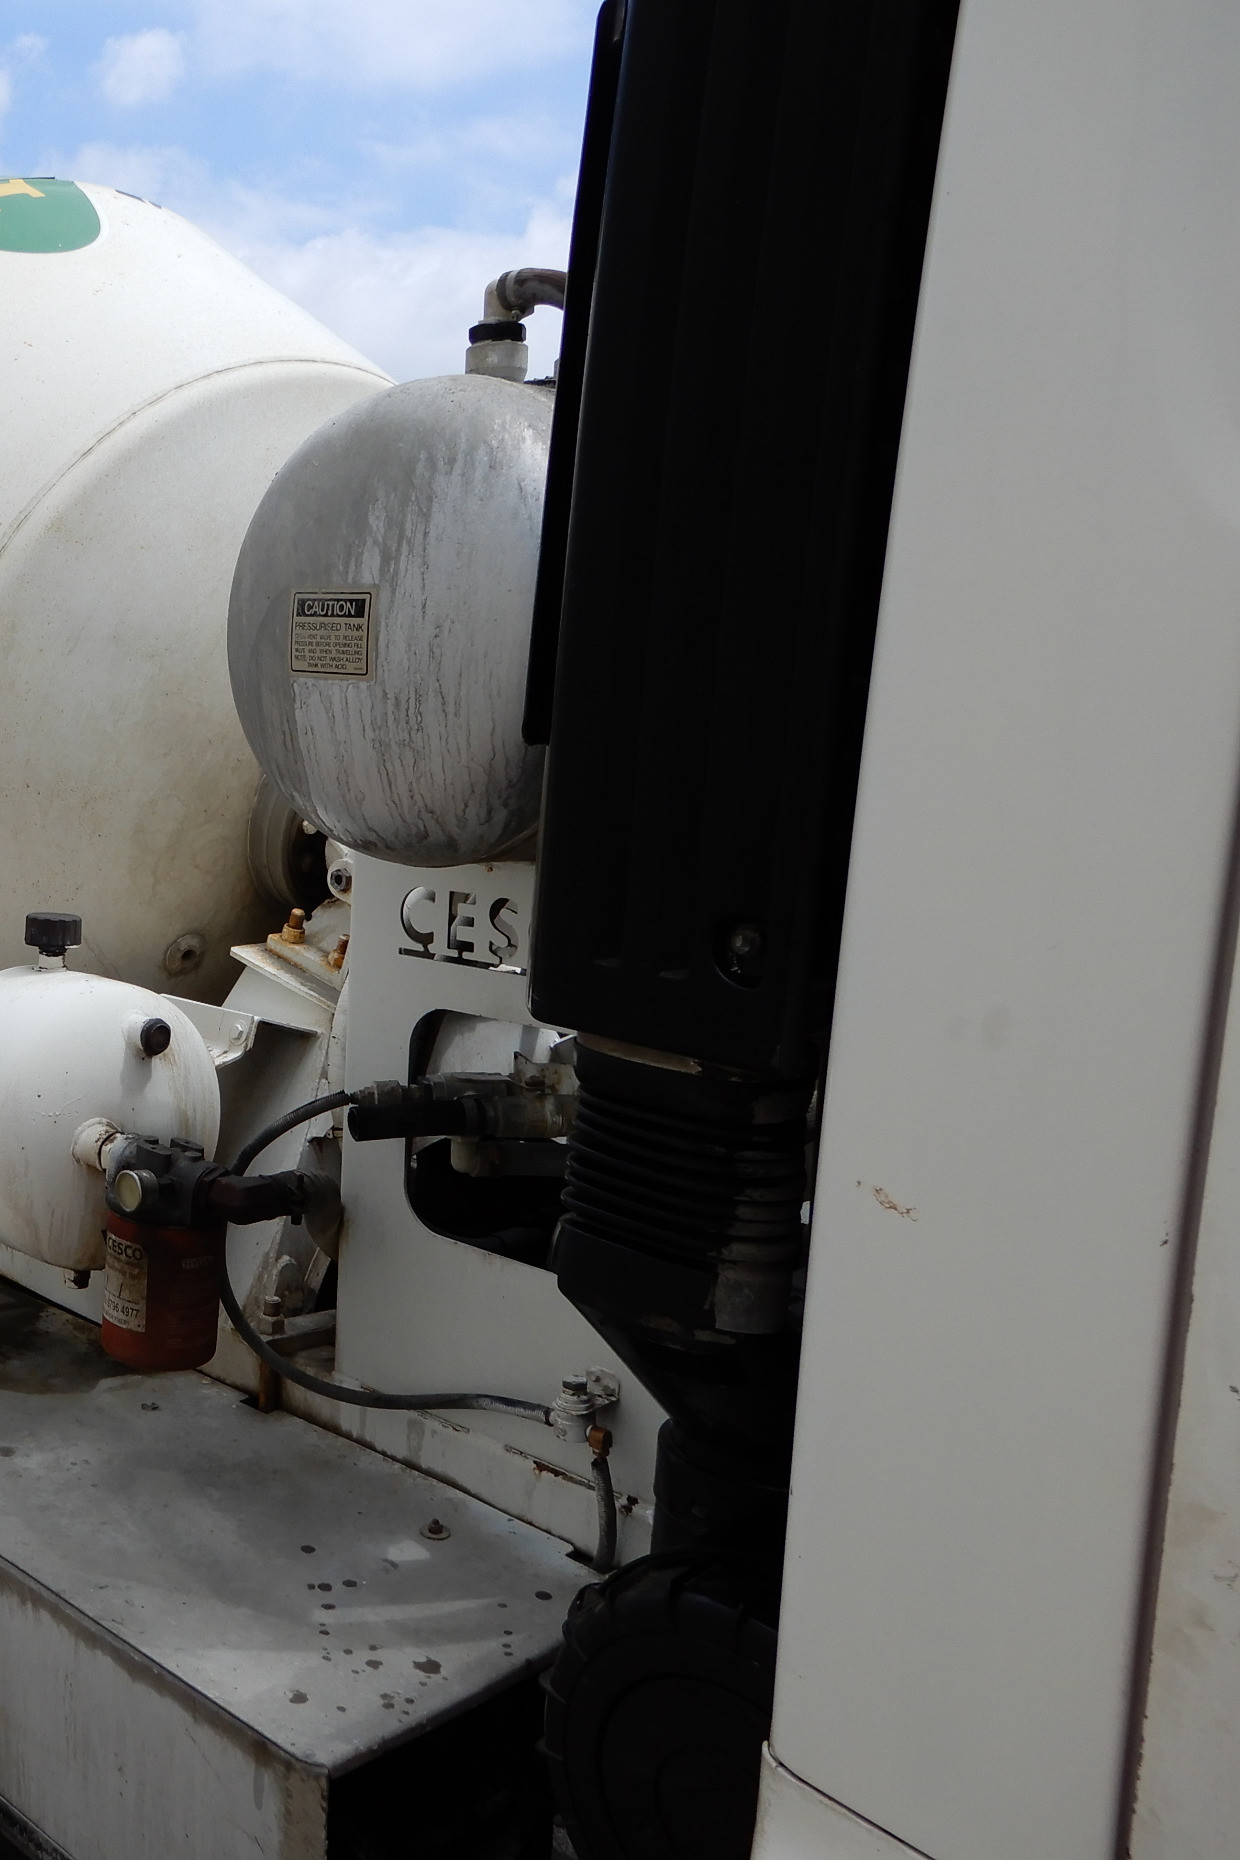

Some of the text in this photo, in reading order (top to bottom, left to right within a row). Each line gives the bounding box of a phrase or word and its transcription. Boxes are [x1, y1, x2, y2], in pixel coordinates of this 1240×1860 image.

[304, 600, 355, 616] CAUTION
[295, 621, 364, 632] PRESSURISED TANK
[333, 641, 353, 649] OPENING
[345, 656, 363, 664] ALLOY
[400, 886, 529, 960] CES
[108, 1236, 142, 1261] CESCO
[121, 1304, 139, 1318] 4977
